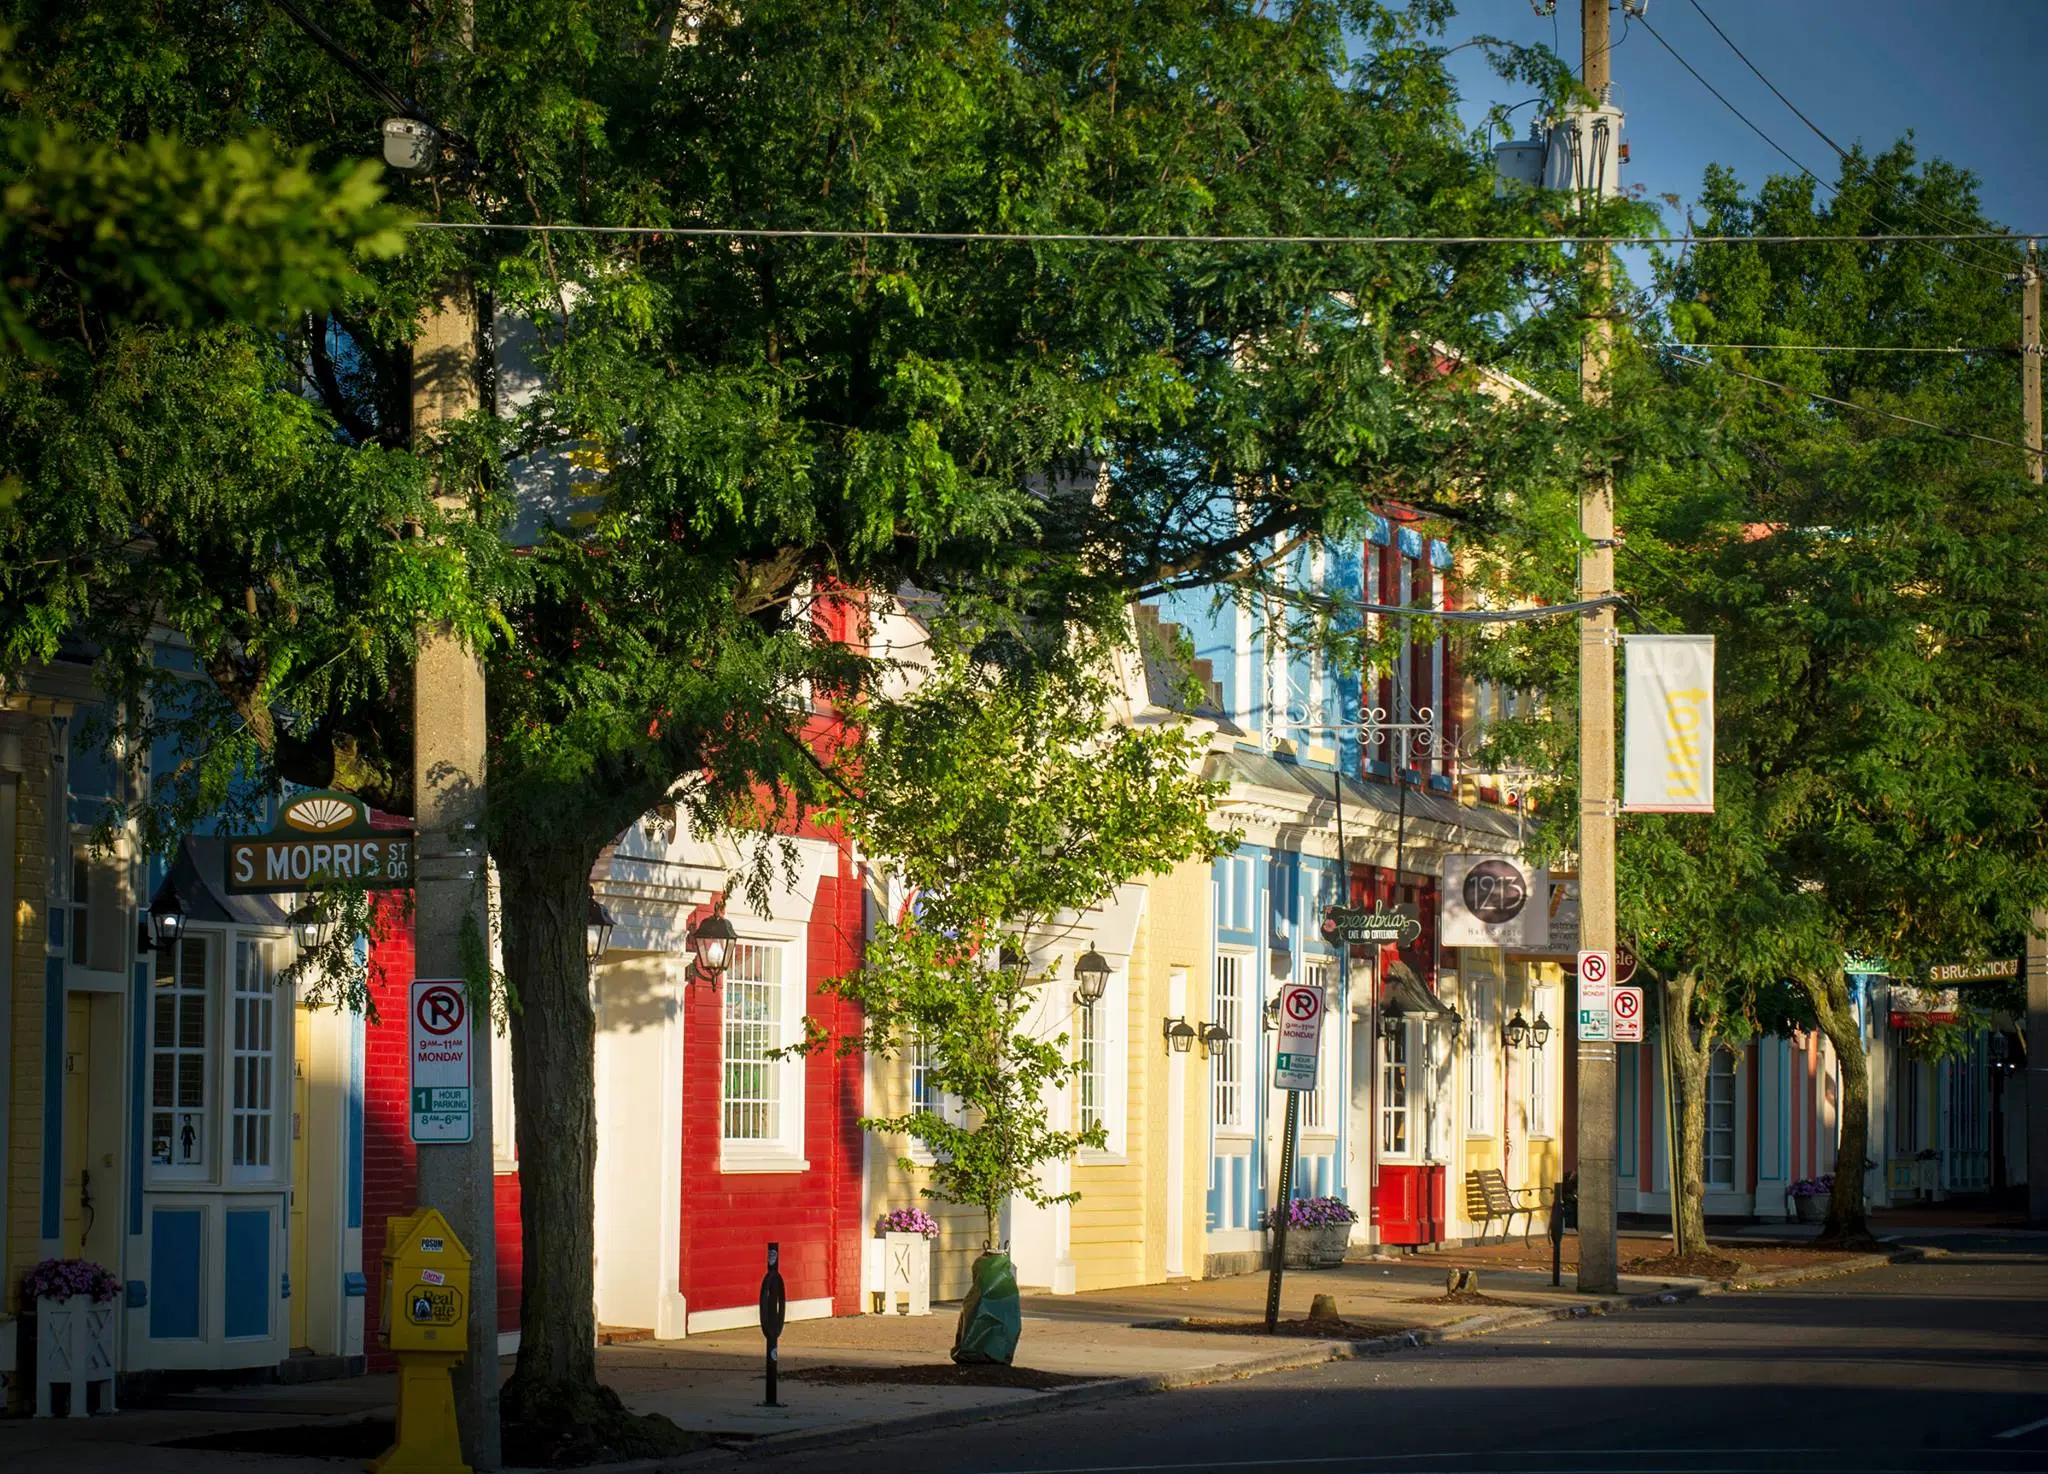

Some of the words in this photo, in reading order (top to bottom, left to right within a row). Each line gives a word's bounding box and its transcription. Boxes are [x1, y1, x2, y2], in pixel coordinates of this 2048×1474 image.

[388, 843, 408, 861] ST
[235, 847, 254, 883] S
[266, 842, 380, 881] MORRIS
[1469, 875, 1524, 910] 1213
[1930, 966, 1938, 981] S
[1283, 1030, 1315, 1039] MONDAY
[418, 1052, 463, 1062] MONDAY
[1280, 1056, 1287, 1068] 1
[418, 1091, 427, 1110] 1
[438, 1091, 461, 1099] HOUR
[433, 1101, 467, 1109] PARKING
